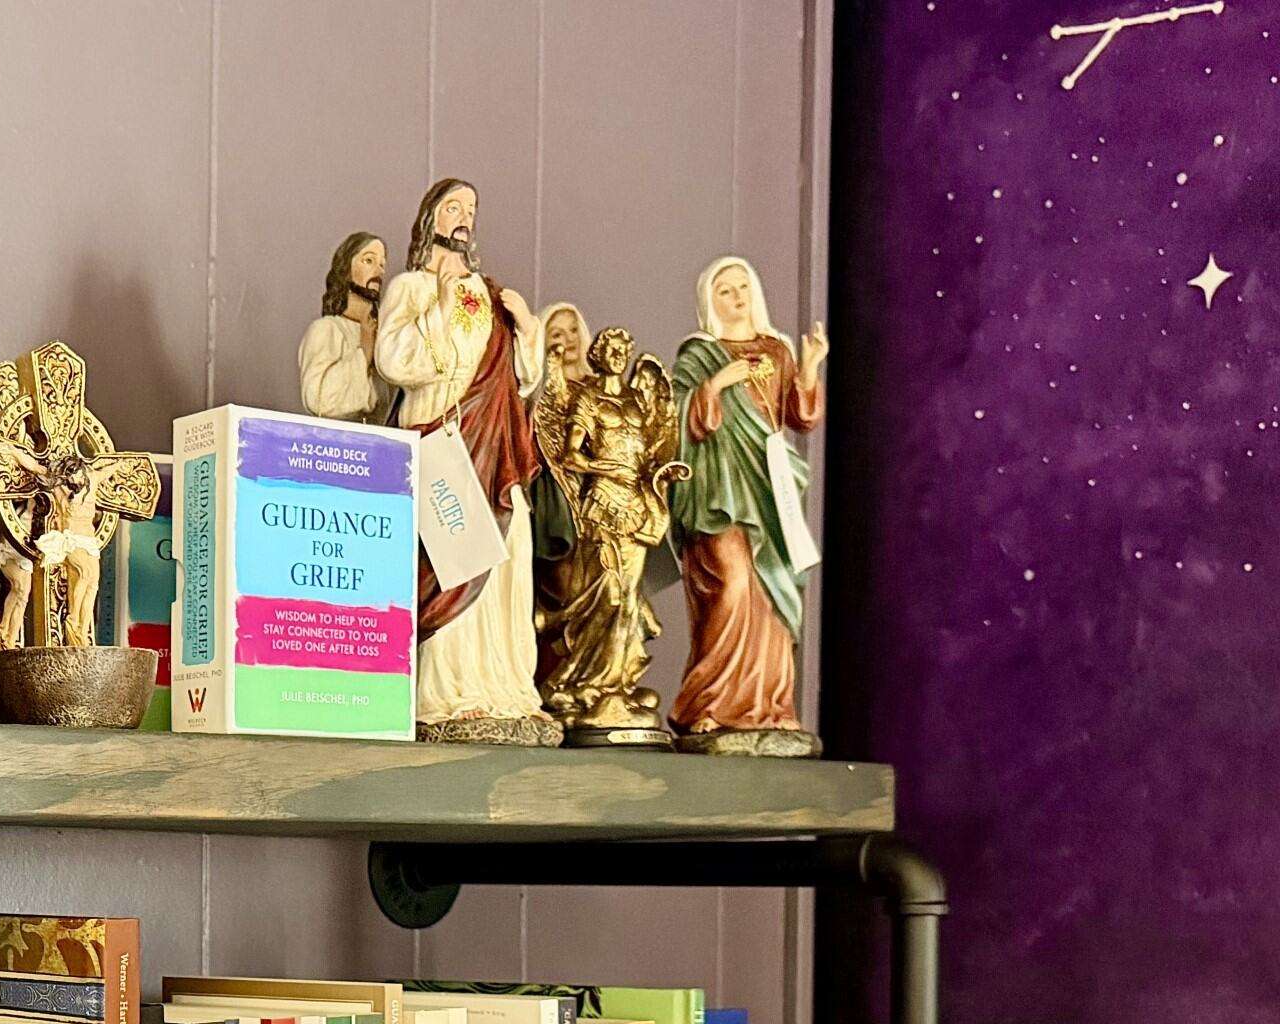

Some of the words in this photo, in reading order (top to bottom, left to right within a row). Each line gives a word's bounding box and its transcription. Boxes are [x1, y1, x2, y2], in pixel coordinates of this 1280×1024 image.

[291, 443, 299, 453] A
[301, 443, 341, 459] 52-CARD
[343, 449, 367, 462] DECK
[289, 457, 313, 471] WITH
[316, 460, 371, 477] GUIDEBOOK
[431, 478, 465, 536] PACIFIC
[261, 502, 393, 540] GUIDANCE
[312, 540, 344, 558] FOR
[290, 562, 365, 591] GRIEF
[275, 610, 317, 623] WISDOM
[320, 613, 333, 624] TO
[335, 614, 355, 626] HELP
[358, 616, 377, 628] YOU
[263, 623, 286, 636] STAY
[288, 625, 345, 640] CONNECTED
[348, 630, 360, 641] TO
[363, 632, 388, 644] YOUR
[272, 639, 299, 652] LOVED
[302, 641, 326, 654] ONE
[329, 643, 356, 656] AFTER
[358, 645, 380, 657] LOSS
[120, 953, 129, 992] Werner
